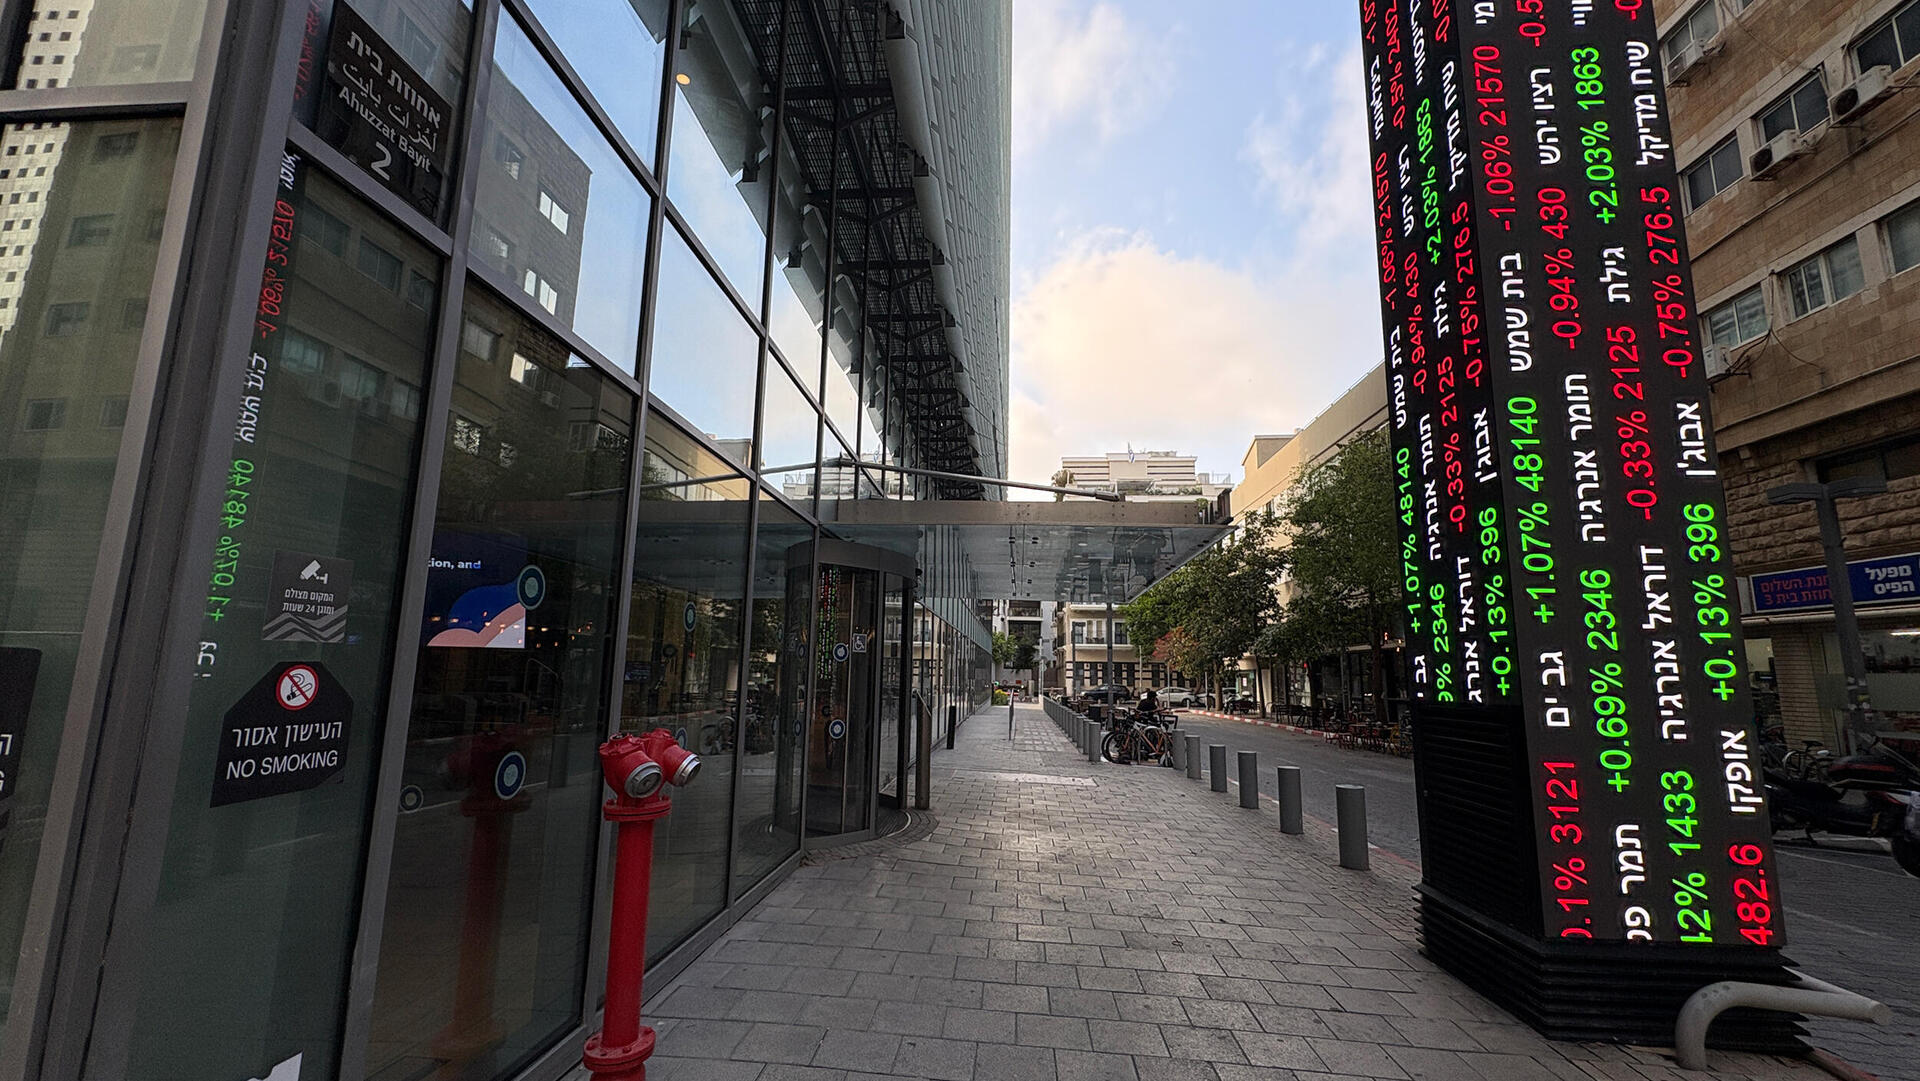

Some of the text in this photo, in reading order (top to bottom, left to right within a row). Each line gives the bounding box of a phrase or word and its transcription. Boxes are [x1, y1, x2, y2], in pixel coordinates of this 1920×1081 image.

[347, 31, 384, 76] בית
[1433, 0, 1449, 42] -0.0
[1370, 54, 1384, 140] בינלאומי
[1389, 61, 1405, 128] -0.5%
[1442, 61, 1458, 110] שיח
[1473, 46, 1506, 125] 21570
[1531, 69, 1554, 109] רציו
[1572, 48, 1604, 110] 1863
[1627, 42, 1651, 84] שיח
[338, 86, 431, 172] Ahuzzat Bayit
[387, 69, 441, 128] אחוזת
[1416, 98, 1433, 163] 1863
[1634, 95, 1669, 165] מדיקל
[370, 141, 393, 181] 2
[1446, 109, 1466, 191] מדיקל
[1536, 120, 1560, 164] יהש
[1580, 121, 1618, 224] +2.03%
[1376, 153, 1391, 229] 21570
[1421, 166, 1441, 264] +2.03%
[1481, 136, 1515, 230] -1.06%
[1538, 188, 1568, 239] 430
[1452, 202, 1473, 283] 276.5
[1641, 187, 1678, 264] 276.5
[1381, 228, 1396, 309] -1.06%
[1405, 252, 1419, 297] 430
[1501, 253, 1524, 298] בית
[1544, 249, 1581, 349] -0.94%
[1600, 247, 1630, 302] גילת
[1433, 281, 1449, 338] גילת
[1459, 286, 1482, 387] -0.75%
[1506, 308, 1532, 371] שמש
[1652, 275, 1693, 377] -0.75%
[1391, 326, 1402, 368] בית
[1408, 305, 1426, 393] -0.94%
[1607, 326, 1643, 400] 2125
[1394, 375, 1406, 429] שמש
[1438, 357, 1457, 426] 2125
[1565, 375, 1592, 440] תומר
[1420, 414, 1433, 475] תומר
[1508, 397, 1544, 492] 48140
[1616, 411, 1657, 520] -0.33%
[1677, 403, 1716, 475] אבוג'ן
[1397, 448, 1413, 525] 48140
[1444, 433, 1465, 532] -0.33%
[1573, 450, 1605, 541] אנרגיה
[1425, 480, 1441, 560] אנרגיה
[1479, 508, 1500, 565] 396
[1684, 504, 1720, 562] 396
[284, 588, 334, 602] המקום מצולם
[458, 560, 481, 569] and
[1403, 534, 1421, 632] +1.07%
[1457, 557, 1475, 632] דוראל
[1518, 503, 1556, 623] +1.07%
[1640, 546, 1672, 629] דוראל
[1760, 578, 1802, 592] השלום
[1776, 592, 1799, 603] בית
[1865, 565, 1912, 581] מפעל
[1874, 581, 1915, 595] הפיס
[282, 602, 305, 612] שעות
[305, 604, 315, 613] 24
[1430, 584, 1449, 652] 2346
[1580, 570, 1618, 651] 2346
[1764, 594, 1773, 605] 3
[1415, 655, 1426, 683] גב
[1485, 575, 1511, 696] +0.13%
[1540, 652, 1565, 686] גב
[1692, 575, 1736, 700] +0.13%
[1545, 698, 1570, 726] ים
[1652, 641, 1686, 739] אנרגיה
[232, 721, 343, 748] העישון אסור
[1589, 663, 1631, 792] +0.69%
[226, 750, 338, 780] NO SMOKING
[1721, 731, 1763, 812] אופקו
[1544, 762, 1582, 844] 3121
[1661, 771, 1700, 856] 1433
[1616, 825, 1645, 894] תמר
[1729, 845, 1773, 945] 482.6
